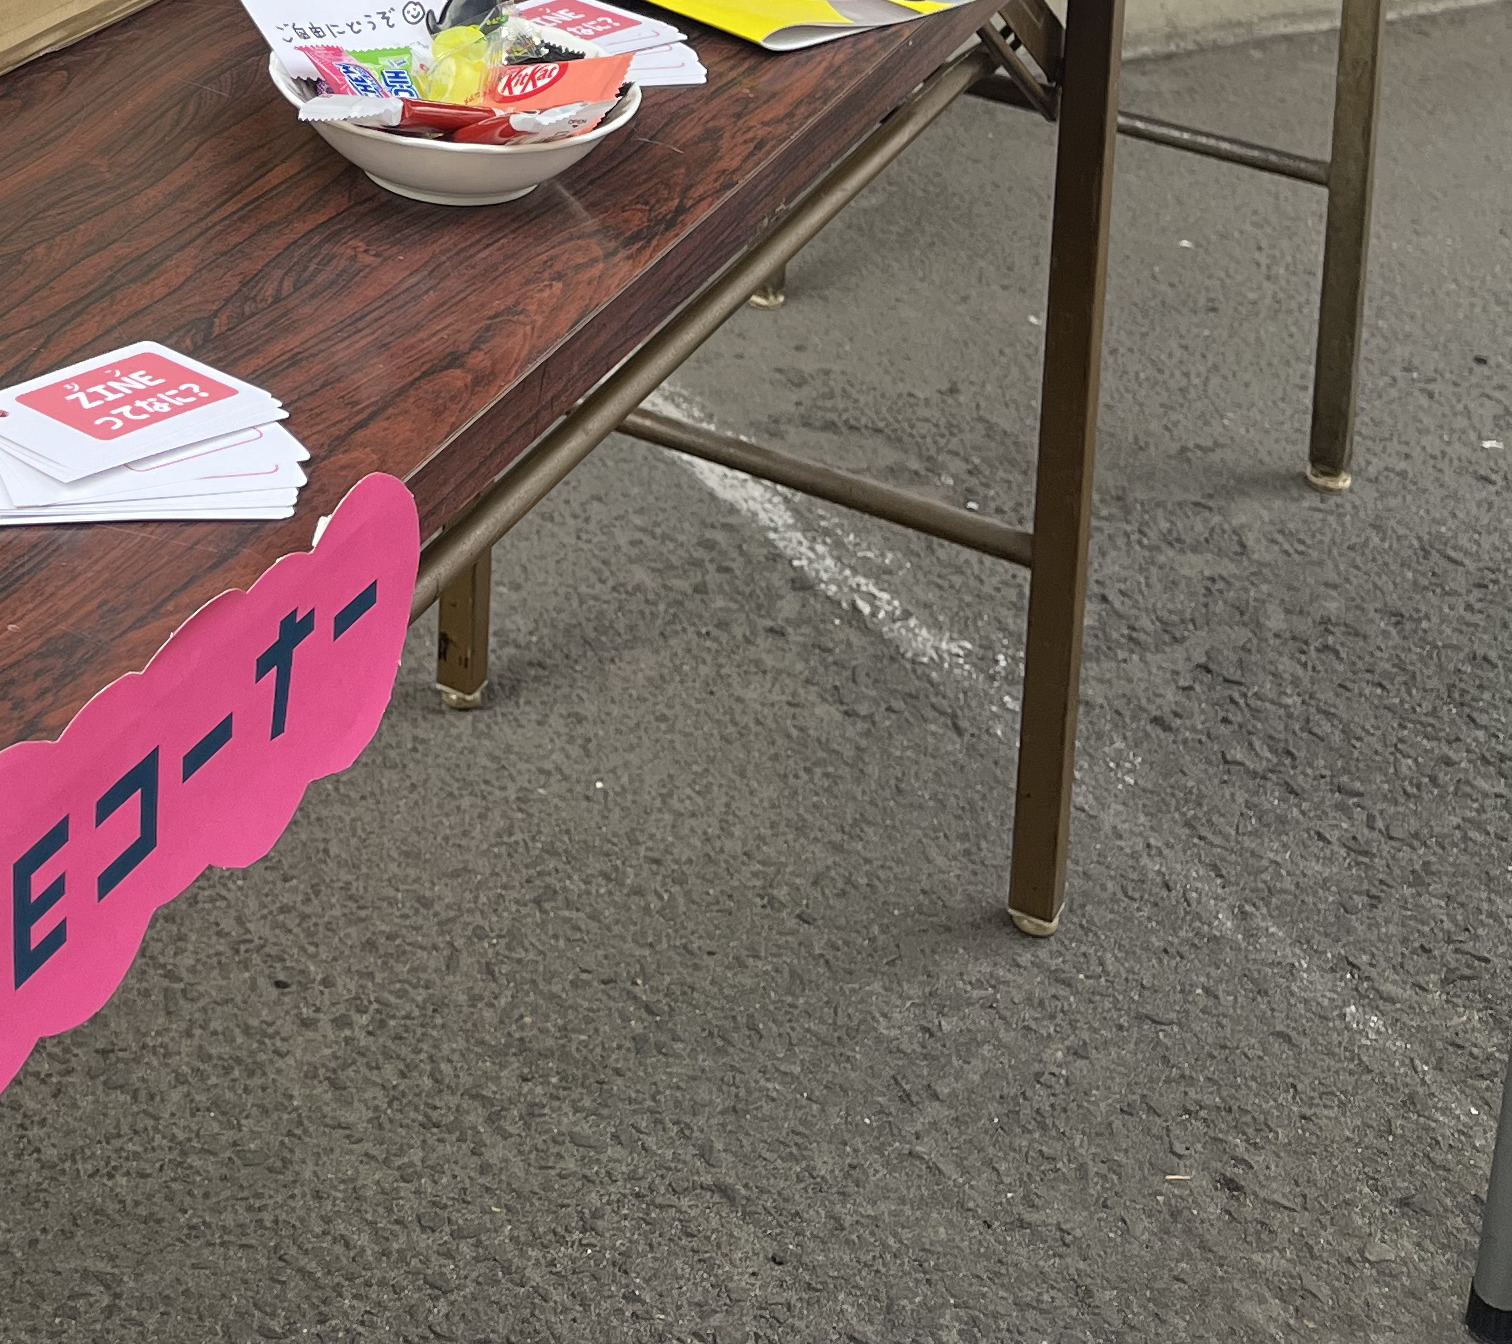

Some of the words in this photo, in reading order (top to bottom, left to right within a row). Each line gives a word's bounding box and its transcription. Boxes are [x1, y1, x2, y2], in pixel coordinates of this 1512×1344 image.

[274, 5, 398, 46] ご自由にどうぞ
[530, 5, 587, 29] INE
[499, 64, 561, 97] KitKat
[567, 118, 588, 126] OPEN
[64, 369, 167, 411] ZINE
[92, 382, 211, 431] ってなに?
